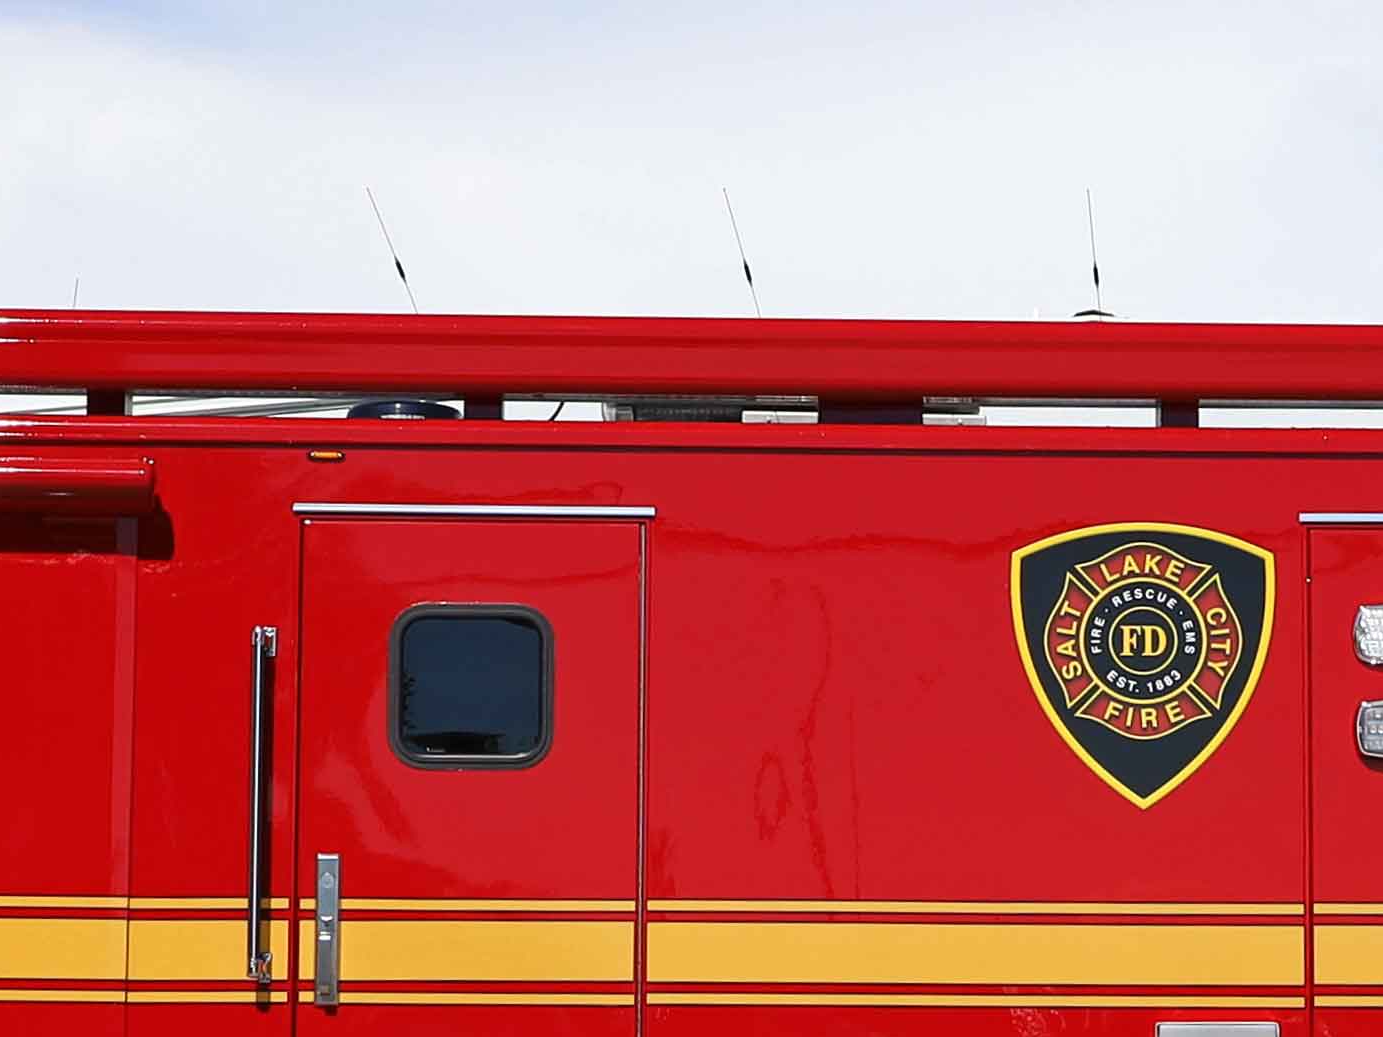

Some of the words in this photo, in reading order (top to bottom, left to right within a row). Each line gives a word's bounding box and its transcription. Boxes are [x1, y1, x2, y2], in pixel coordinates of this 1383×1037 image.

[1056, 600, 1083, 679] SALT
[1099, 553, 1185, 583] LAKE
[1206, 608, 1233, 677] CITY
[1091, 617, 1106, 654] FIRE
[1112, 588, 1178, 609] RESCUE
[1182, 621, 1196, 655] EMS
[1120, 625, 1167, 657] FD
[1106, 670, 1140, 693] EST.
[1104, 701, 1185, 728] FIRE
